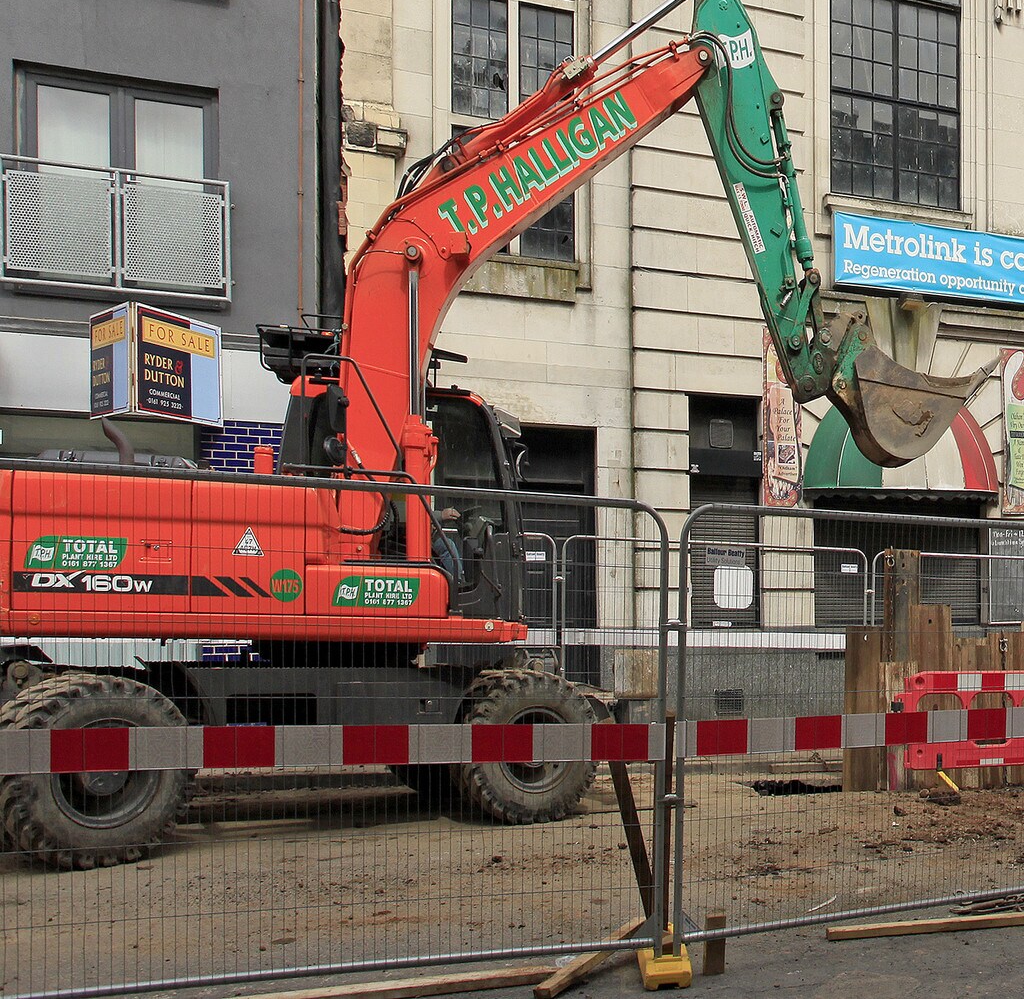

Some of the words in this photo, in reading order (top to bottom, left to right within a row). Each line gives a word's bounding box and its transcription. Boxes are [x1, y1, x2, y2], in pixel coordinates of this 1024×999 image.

[843, 223, 967, 263] Metrolink
[973, 241, 994, 267] is
[843, 259, 937, 284] Regeneration
[939, 274, 1016, 296] opportunity
[94, 328, 106, 342] FOR
[108, 320, 123, 338] SALE
[149, 323, 175, 344] FOR
[181, 332, 210, 353] SALE
[144, 352, 174, 371] RYDER
[174, 360, 184, 375] &
[144, 368, 185, 389] DUTTON
[149, 388, 181, 401] COMMERCIAL
[773, 408, 792, 416] Palace
[62, 539, 118, 554] TOTAL
[707, 547, 727, 556] Balfour
[727, 548, 744, 558] Beatty
[271, 578, 299, 594] W175
[364, 579, 413, 593] TOTAL
